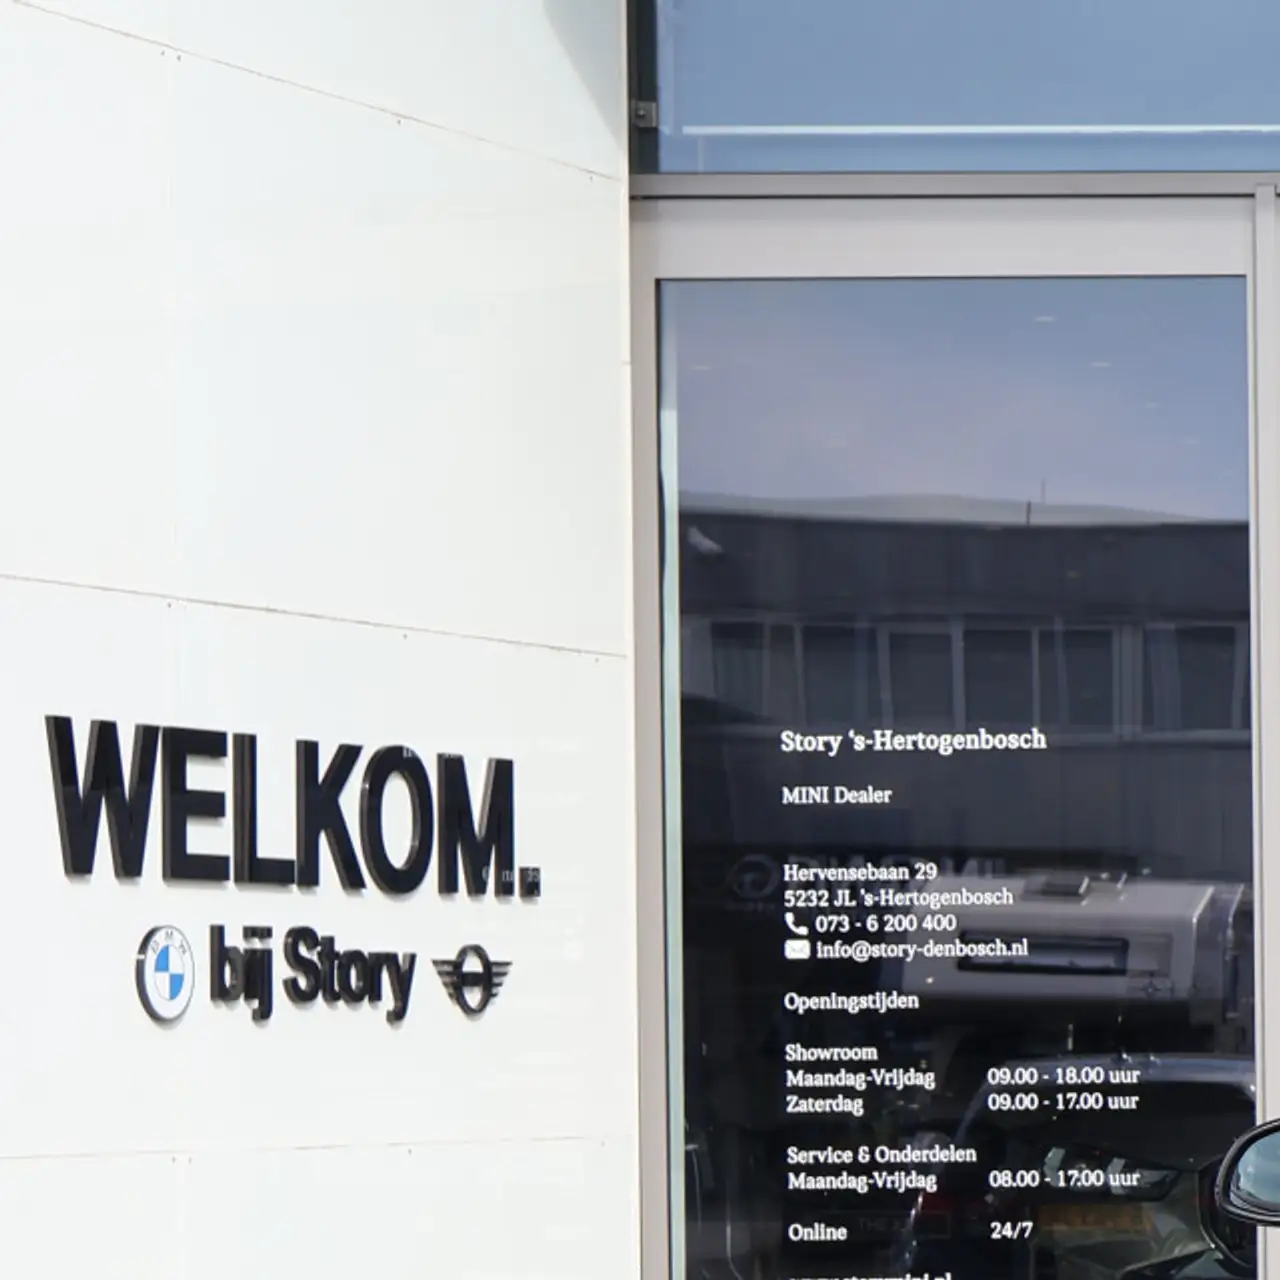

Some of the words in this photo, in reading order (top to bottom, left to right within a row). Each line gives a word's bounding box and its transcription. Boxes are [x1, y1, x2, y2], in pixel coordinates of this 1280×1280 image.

[780, 729, 843, 757] Story
[45, 714, 541, 897] WELKOM.
[781, 786, 829, 804] MINI
[833, 786, 893, 804] Dealer
[782, 863, 910, 881] Hervensebaan
[914, 862, 938, 881] 29
[783, 890, 830, 907] 5232
[833, 889, 857, 907] JL
[815, 915, 850, 933] 073
[866, 915, 879, 932] 6
[883, 914, 918, 932] 200
[922, 914, 957, 931] 400
[816, 938, 1029, 963] info@story-denbosch.nl
[209, 924, 274, 1021] bij
[282, 926, 417, 1024] Story
[783, 992, 920, 1014] Openingstijden
[785, 1044, 879, 1062] Showroom
[785, 1069, 936, 1090] Maandag-Vrijdag
[987, 1068, 1039, 1086] 09.00
[1054, 1067, 1105, 1085] 18.00
[1108, 1069, 1141, 1084] uur
[786, 1094, 864, 1117] Zaterdag
[987, 1094, 1039, 1111] 09.00
[1054, 1093, 1104, 1111] 17.00
[1107, 1095, 1139, 1110] uur
[786, 1146, 853, 1164] Service
[857, 1146, 871, 1164] &
[874, 1145, 977, 1163] Onderdelen
[788, 1171, 937, 1193] Maandag-Vrijdag
[988, 1170, 1040, 1188] 08.00
[1056, 1170, 1105, 1187] 17.00
[1108, 1172, 1141, 1187] uur
[788, 1223, 848, 1241] Online
[989, 1222, 1033, 1240] 24/7
